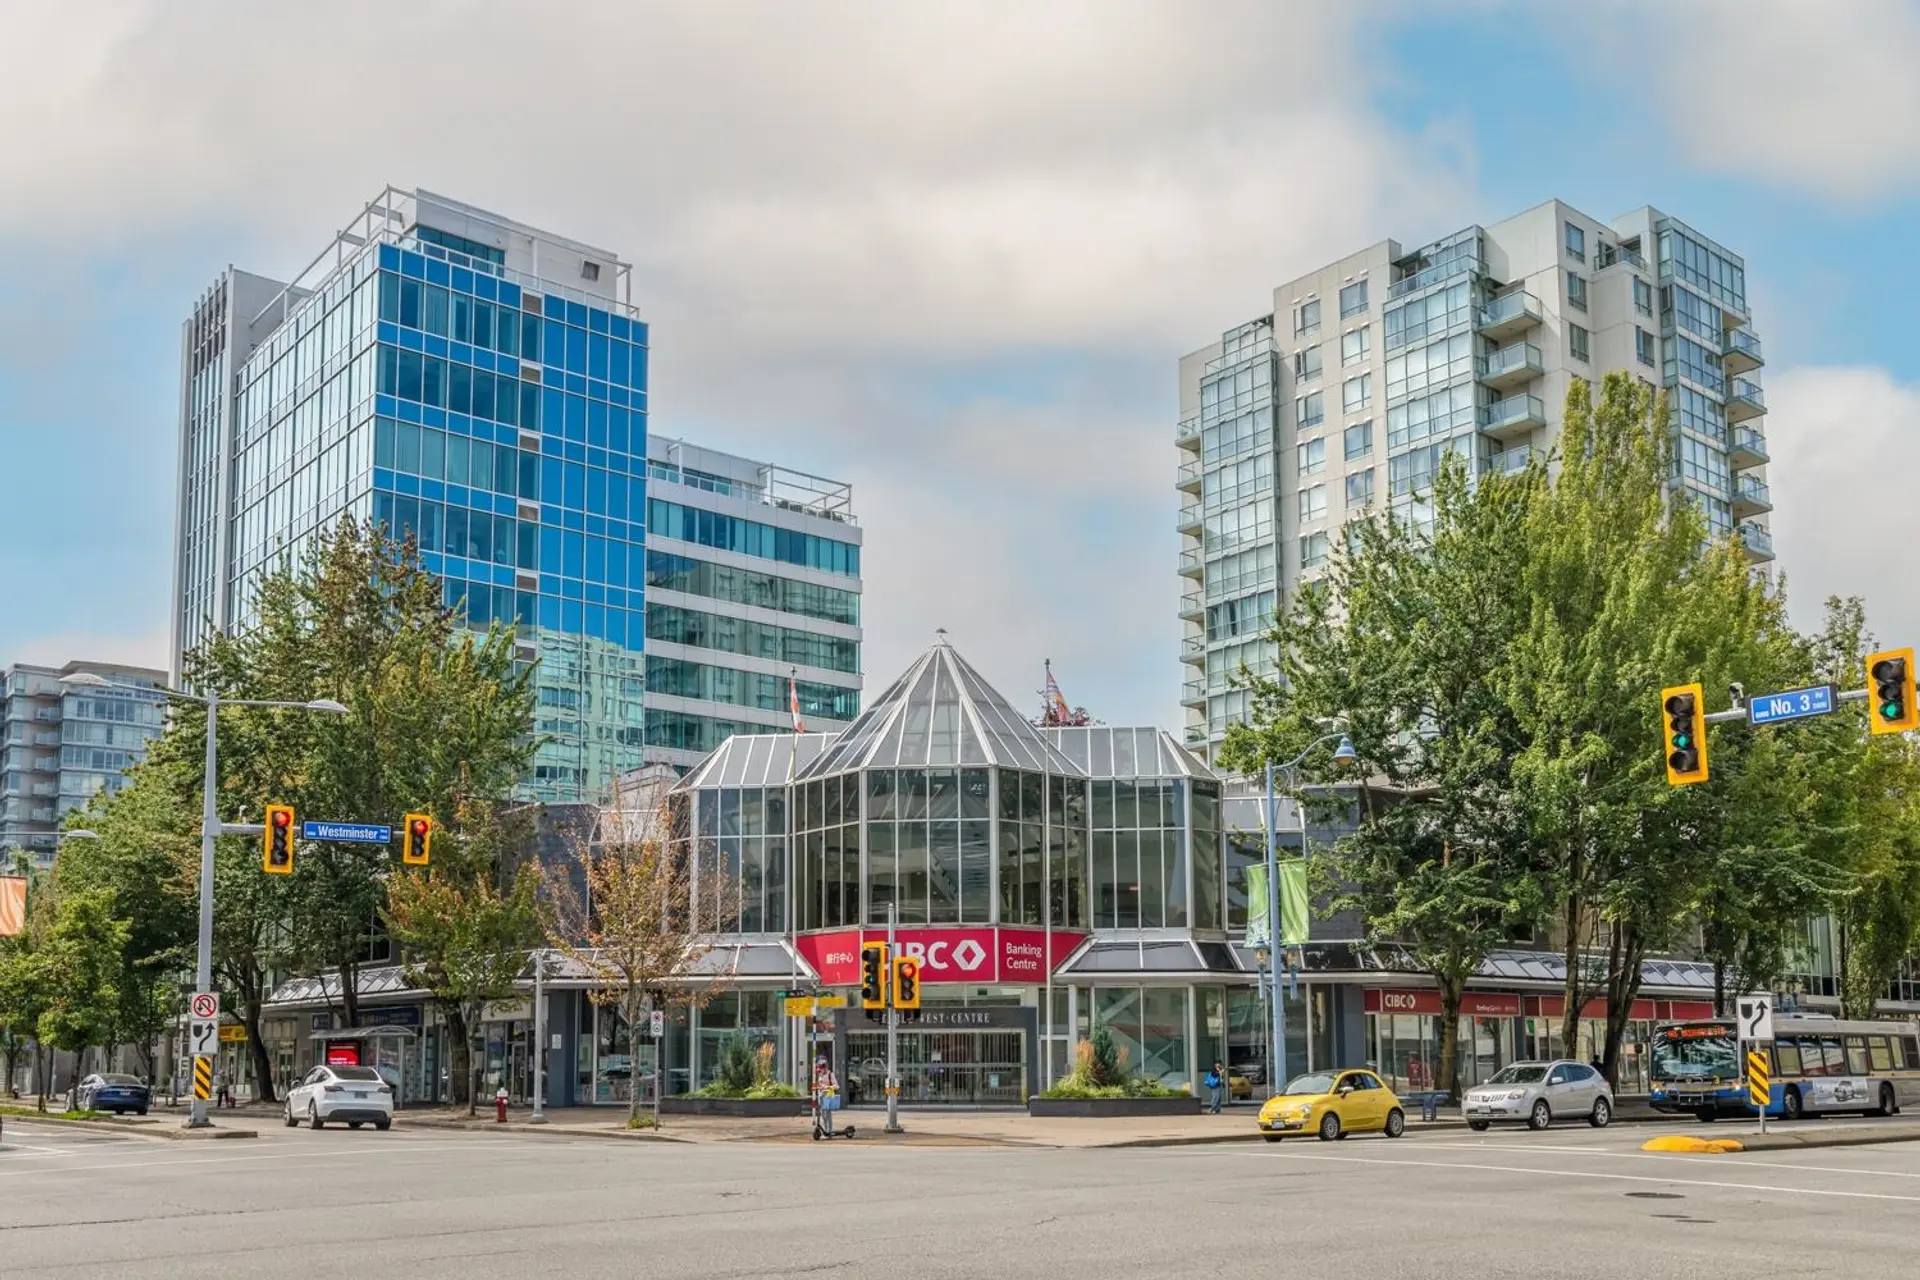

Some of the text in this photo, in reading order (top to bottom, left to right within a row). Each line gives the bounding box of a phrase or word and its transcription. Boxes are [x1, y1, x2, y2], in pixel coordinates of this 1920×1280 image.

[1770, 698, 1796, 716] No.
[1800, 694, 1811, 712] 3
[317, 825, 379, 840] Westminster
[885, 941, 949, 970] IBC
[1006, 942, 1043, 958] Banking
[1006, 957, 1038, 970] Centre
[1384, 994, 1407, 1008] CIBC
[950, 1012, 990, 1024] CENTRE
